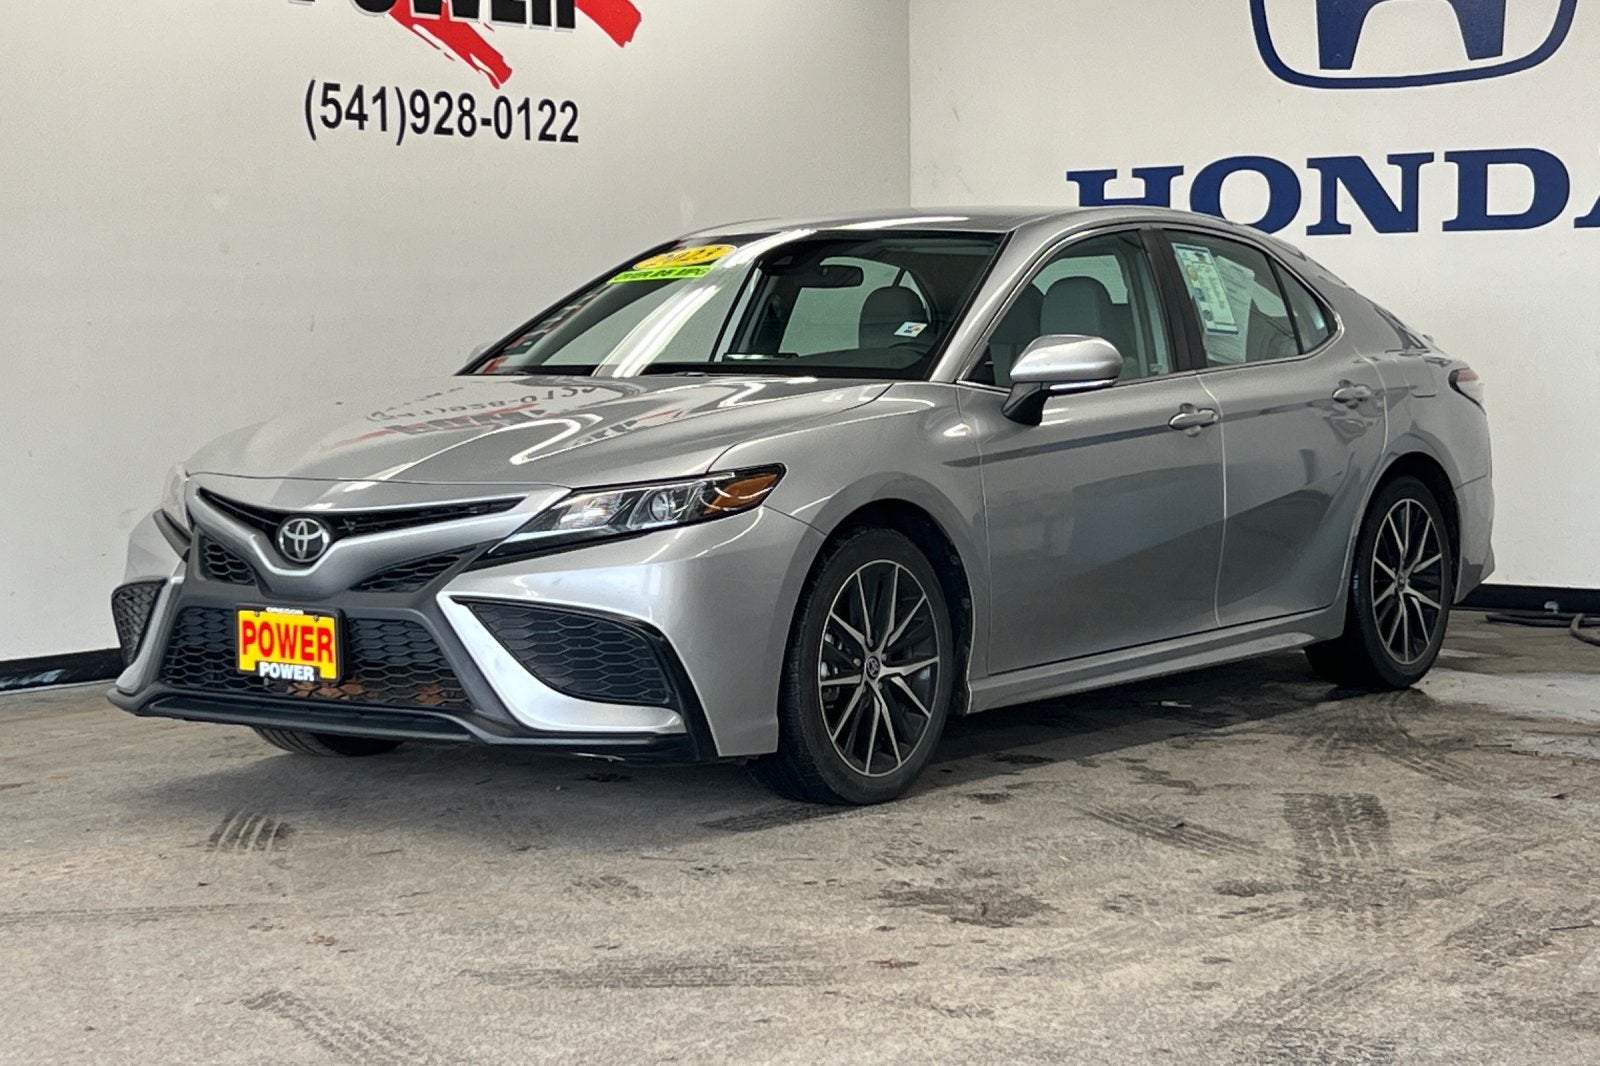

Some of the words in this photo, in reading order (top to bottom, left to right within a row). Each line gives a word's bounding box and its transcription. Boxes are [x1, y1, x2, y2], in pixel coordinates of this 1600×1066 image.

[304, 77, 580, 146] (541)928-0122
[1067, 148, 1600, 235] HOND
[242, 620, 334, 663] POWER
[259, 661, 316, 682] POWER
